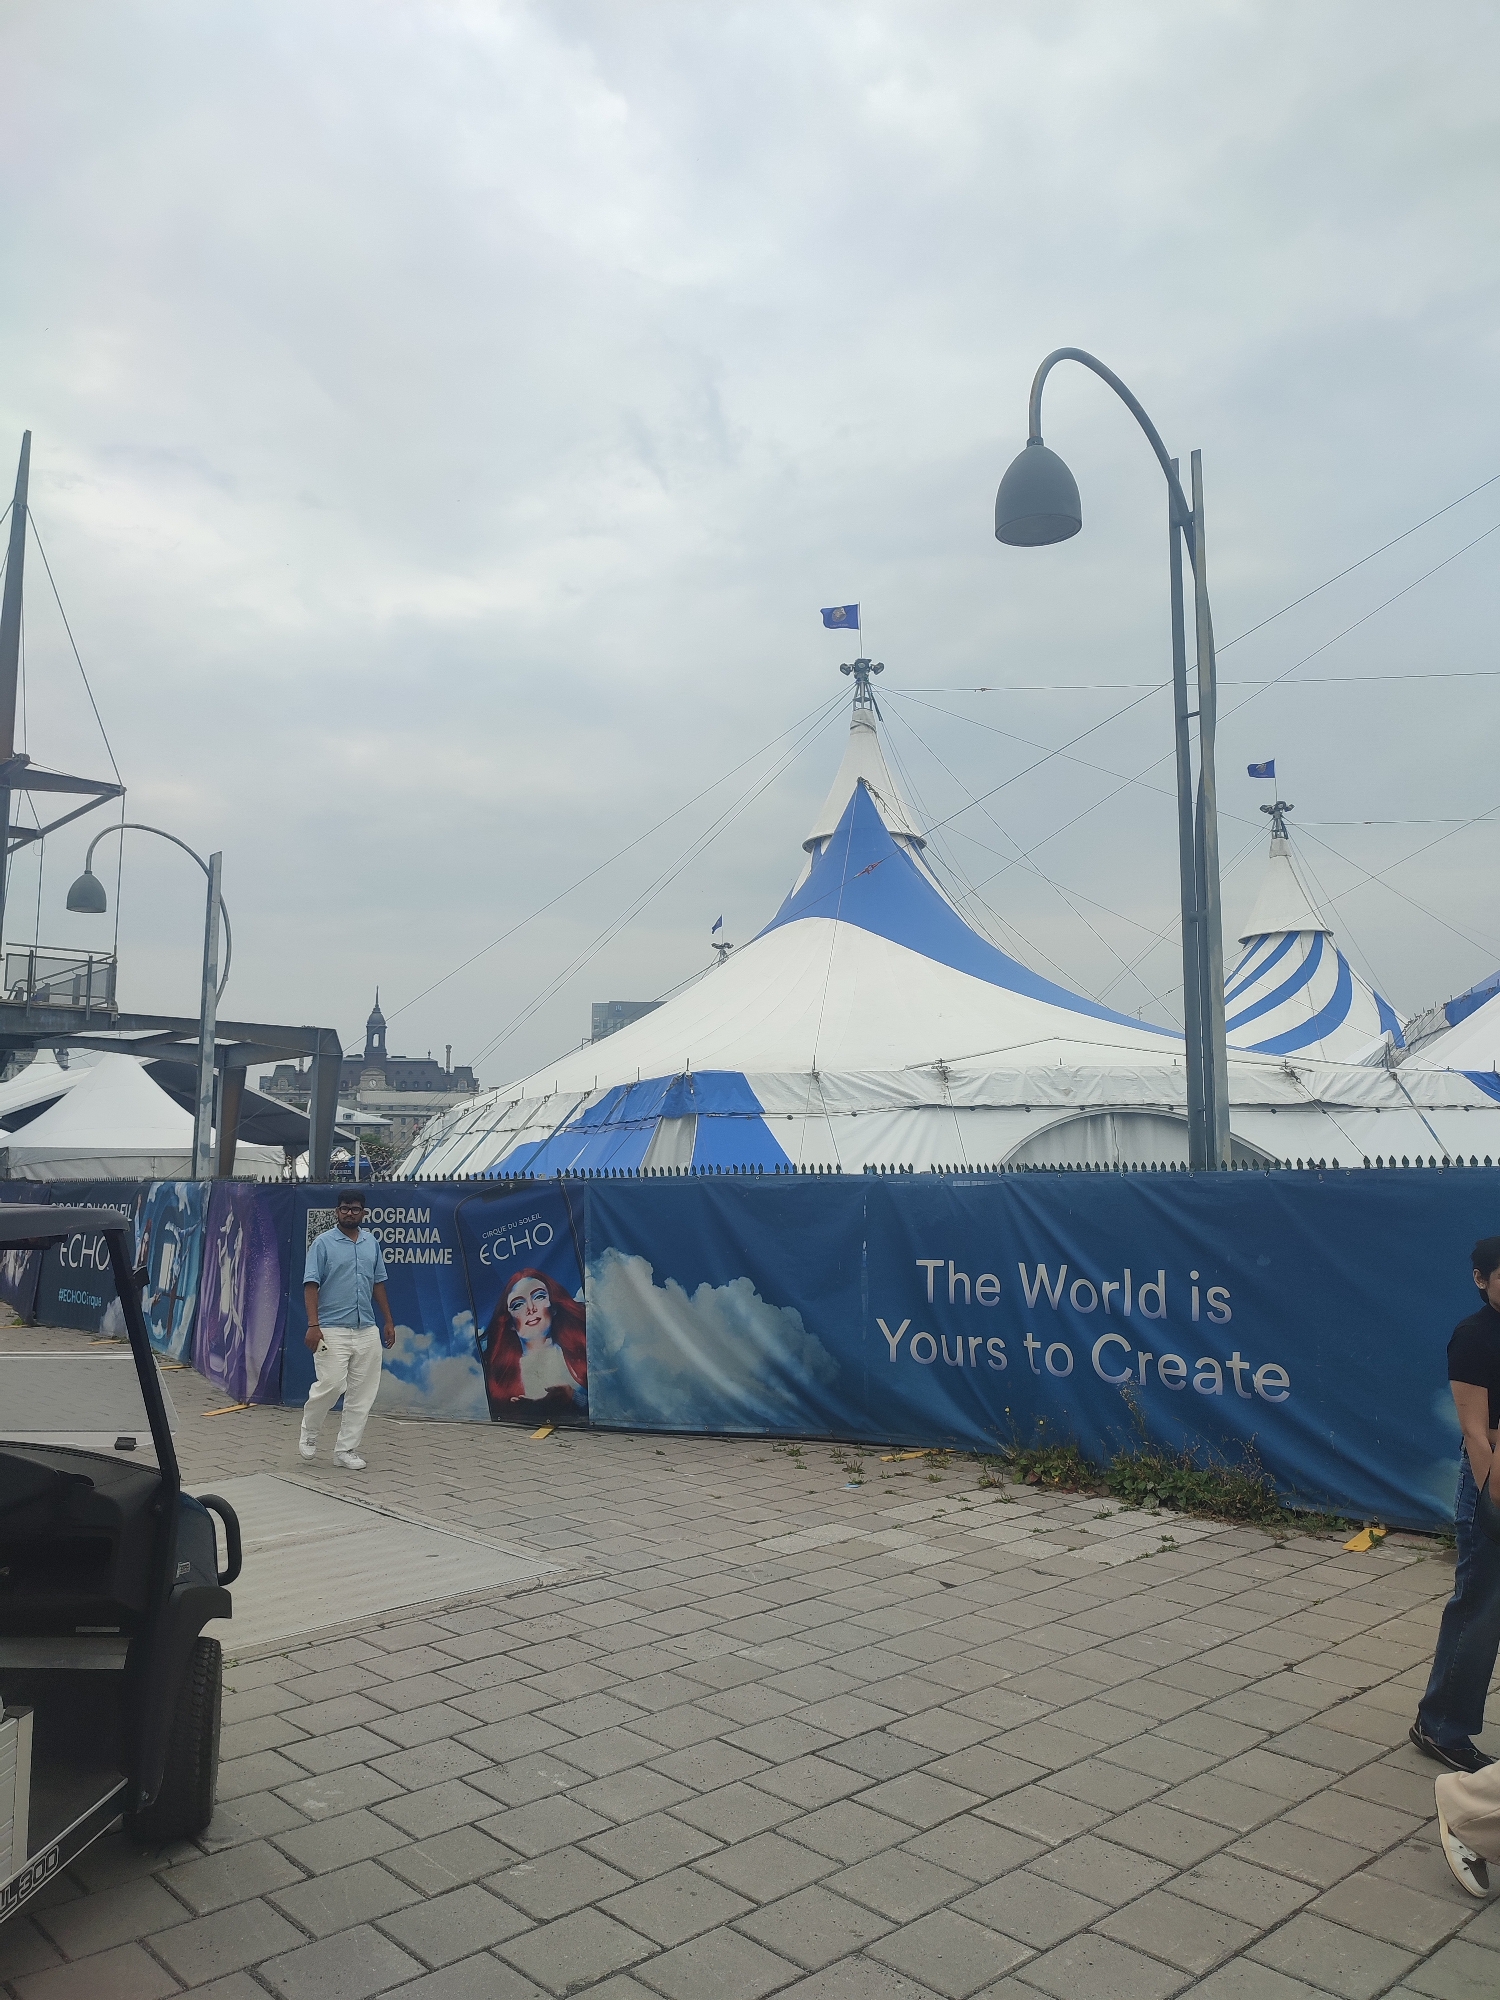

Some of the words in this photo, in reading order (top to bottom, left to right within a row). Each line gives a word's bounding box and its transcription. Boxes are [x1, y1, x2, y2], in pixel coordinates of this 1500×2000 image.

[362, 1207, 430, 1224] ROGRAM
[482, 1225, 507, 1239] CIRQUE
[508, 1222, 518, 1230] DU
[519, 1213, 542, 1226] SOLEIL
[361, 1227, 441, 1244] OGRAMA
[480, 1223, 554, 1266] ECHO
[60, 1233, 110, 1271] ECHO
[382, 1248, 453, 1265] GRAMME
[58, 1288, 102, 1309] #ECHOCirque
[916, 1259, 1000, 1307] The
[1018, 1262, 1168, 1320] World
[1189, 1270, 1233, 1324] is
[876, 1318, 1008, 1371] Yours
[1023, 1332, 1074, 1378] to
[1091, 1333, 1291, 1403] Create
